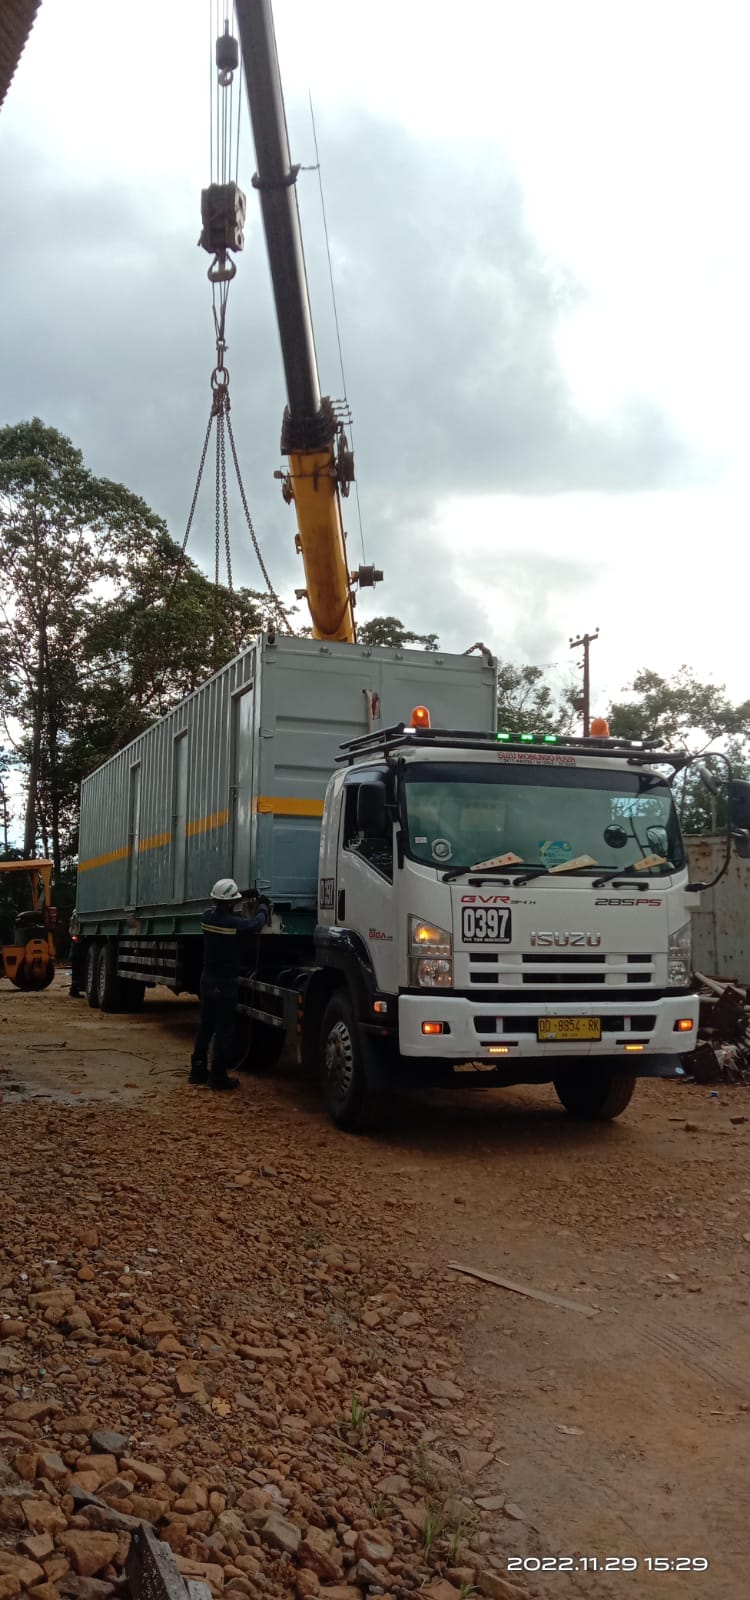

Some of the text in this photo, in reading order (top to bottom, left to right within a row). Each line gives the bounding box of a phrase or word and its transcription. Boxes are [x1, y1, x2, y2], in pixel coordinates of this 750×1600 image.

[460, 895, 510, 904] GVR
[594, 898, 662, 907] 285PS
[463, 908, 510, 938] 0397
[530, 931, 601, 947] ISUZU
